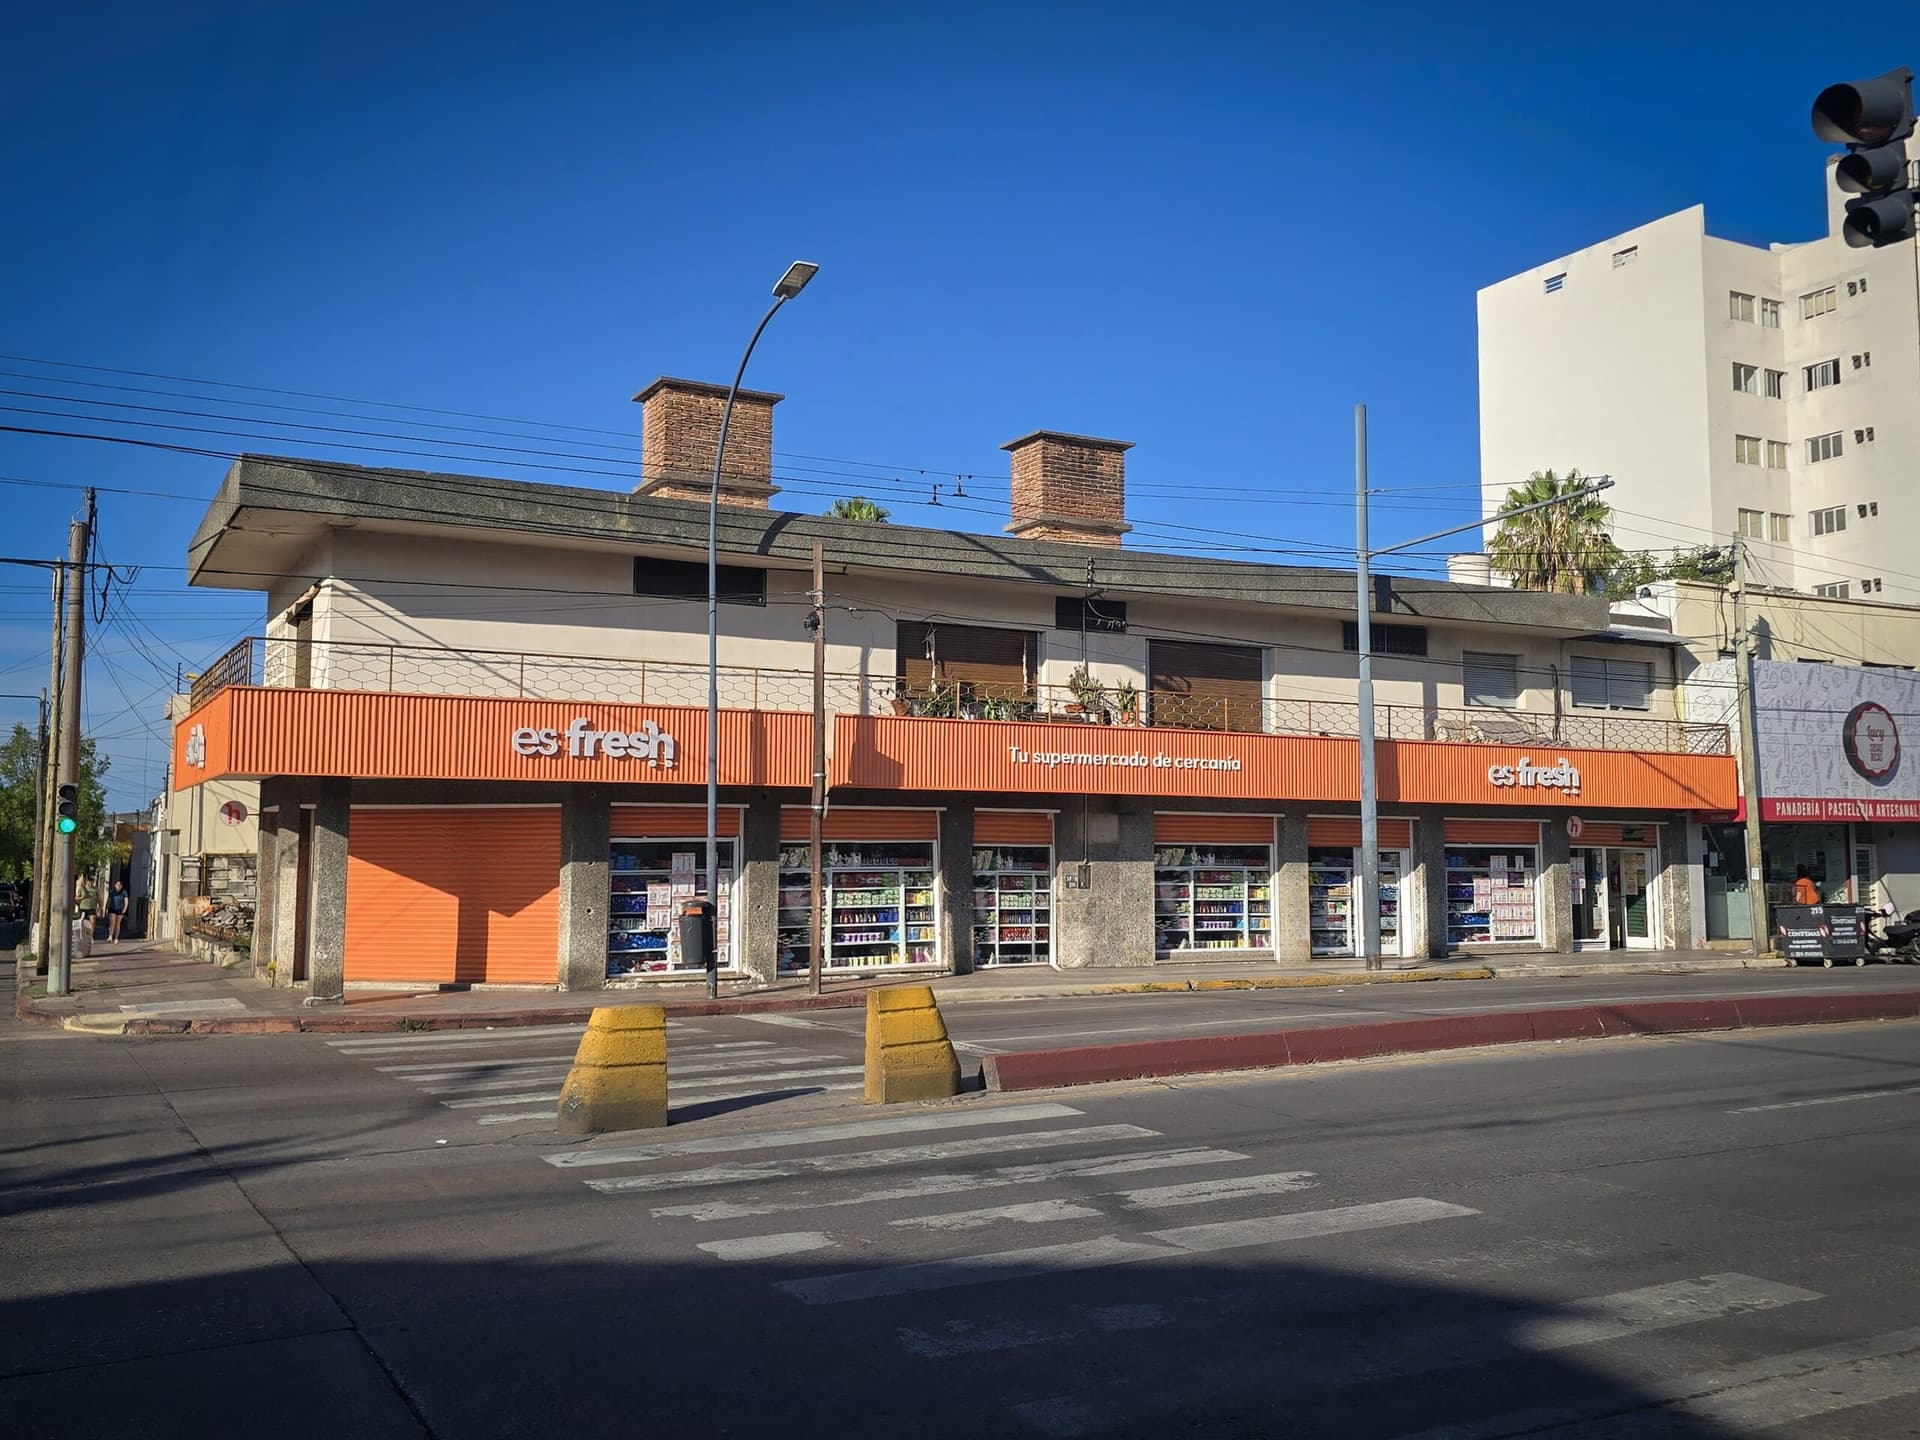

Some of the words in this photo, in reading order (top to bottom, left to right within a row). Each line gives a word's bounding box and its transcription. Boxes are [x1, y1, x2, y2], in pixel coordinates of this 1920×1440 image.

[512, 727, 557, 755] es
[564, 717, 674, 768] fresh
[1009, 745, 1029, 763] Tu
[1033, 750, 1148, 768] supermercado
[1152, 752, 1172, 768] de
[1175, 755, 1241, 771] cercanía
[1488, 765, 1515, 786] es
[1517, 757, 1580, 795] fresh
[1775, 800, 1820, 816] PANADERÍA
[1876, 803, 1918, 817] ARTESANAL
